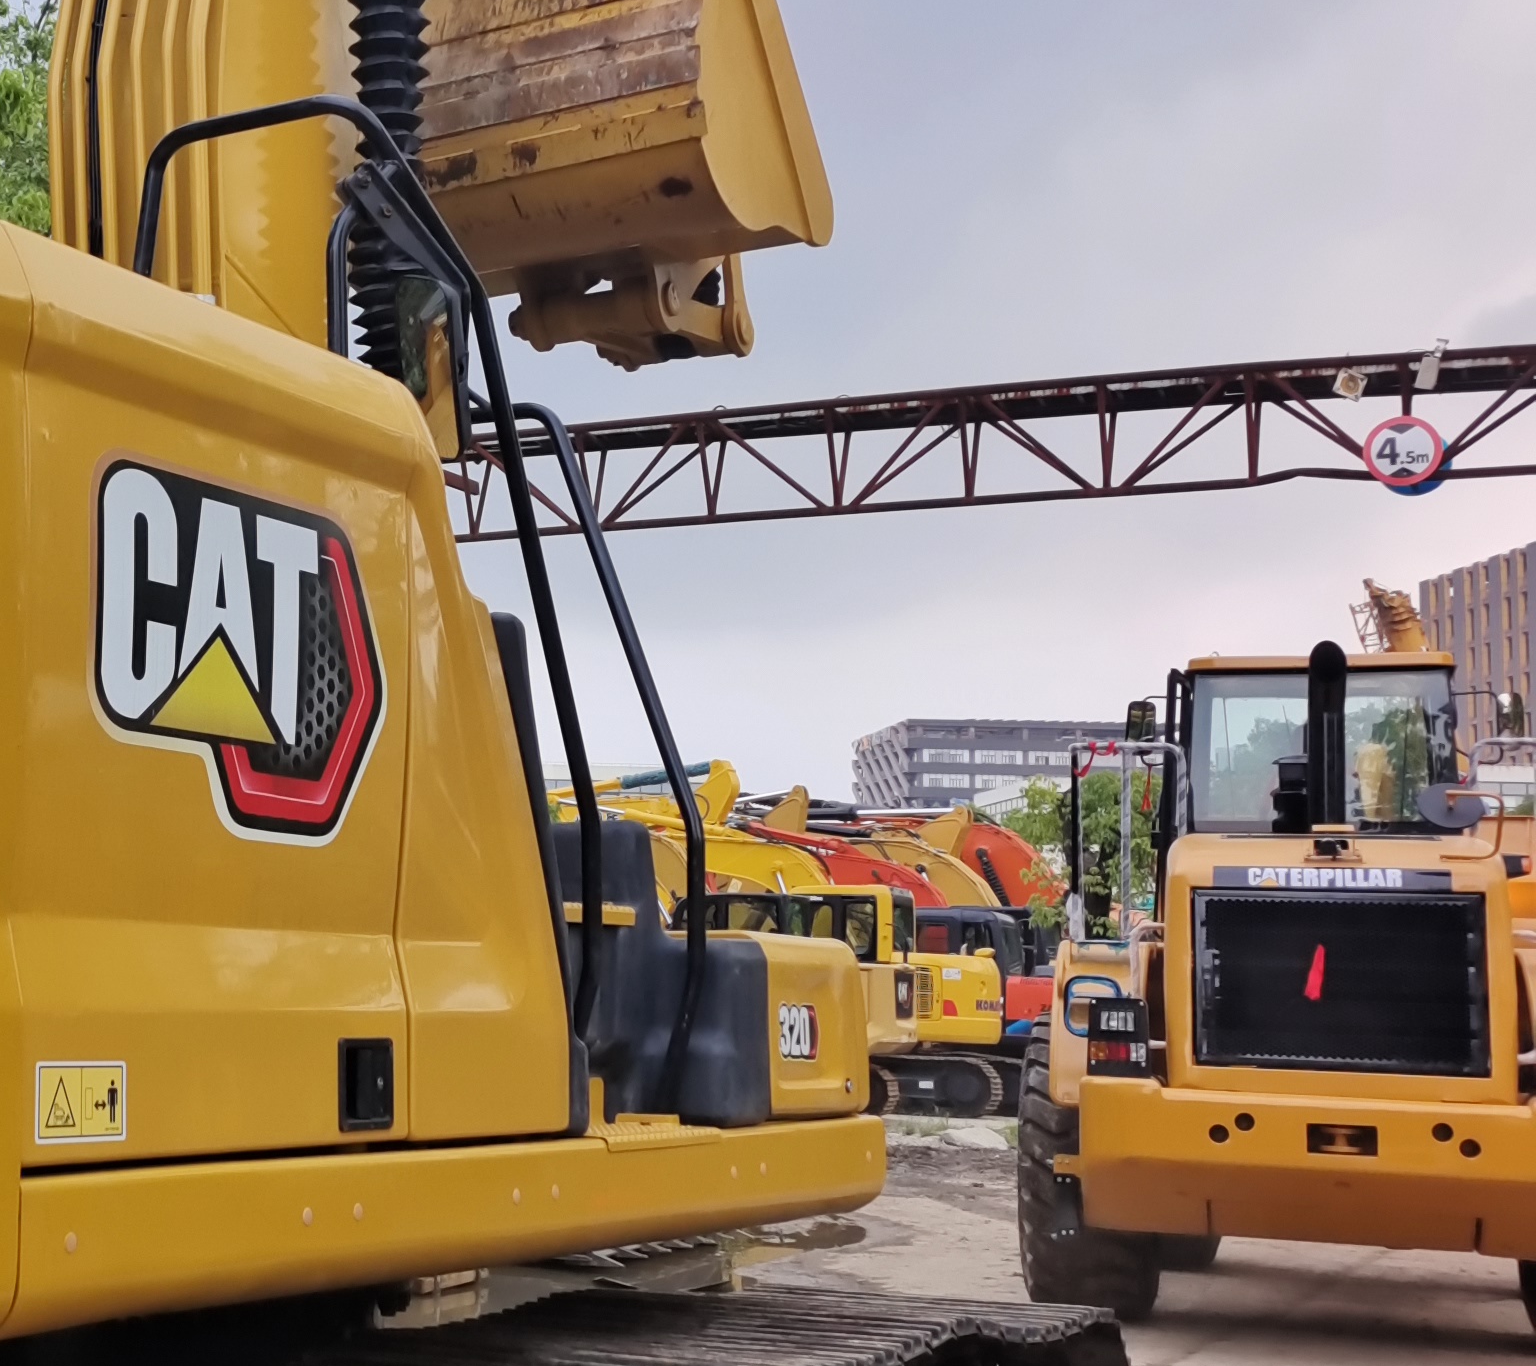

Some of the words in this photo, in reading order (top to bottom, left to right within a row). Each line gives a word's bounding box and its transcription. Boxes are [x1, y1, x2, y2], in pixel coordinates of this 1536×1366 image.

[1375, 436, 1430, 466] 4.5m
[100, 467, 319, 746] CAT
[1247, 867, 1404, 888] CATERPILLAR
[779, 1005, 811, 1056] 320
